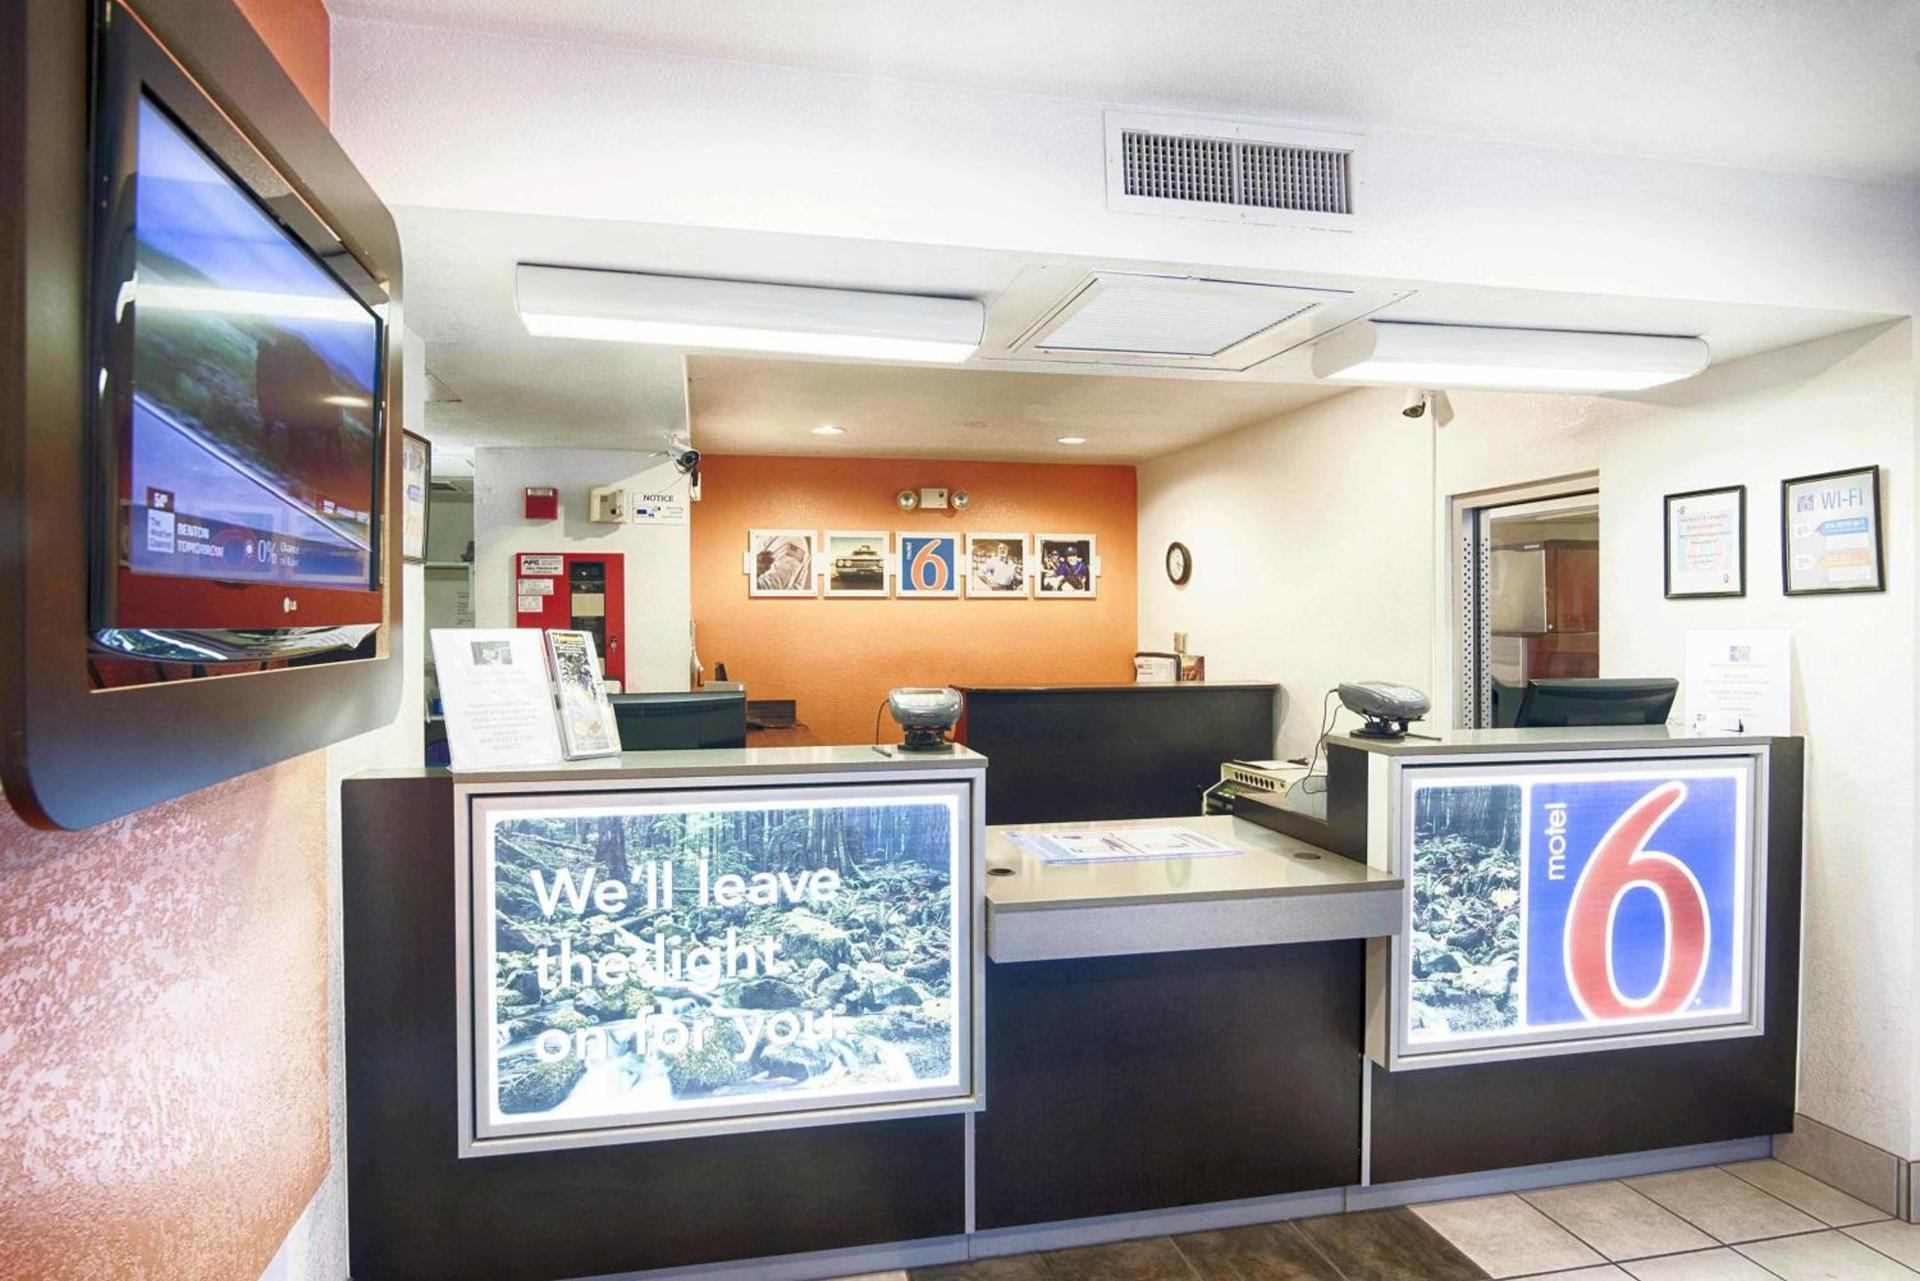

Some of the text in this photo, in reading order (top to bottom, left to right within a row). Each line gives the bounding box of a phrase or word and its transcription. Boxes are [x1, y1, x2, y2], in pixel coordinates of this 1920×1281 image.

[643, 494, 675, 503] NOTICE
[1820, 487, 1864, 510] WI-FI
[177, 522, 210, 540] BENTON
[177, 539, 224, 558] TOMORROW
[911, 538, 948, 592] 6
[1545, 803, 1567, 881] motel
[530, 858, 841, 918] We'll leave
[1563, 780, 1711, 1021] 6
[532, 925, 780, 995] the light
[535, 1025, 608, 1064] on
[634, 1004, 717, 1057] for
